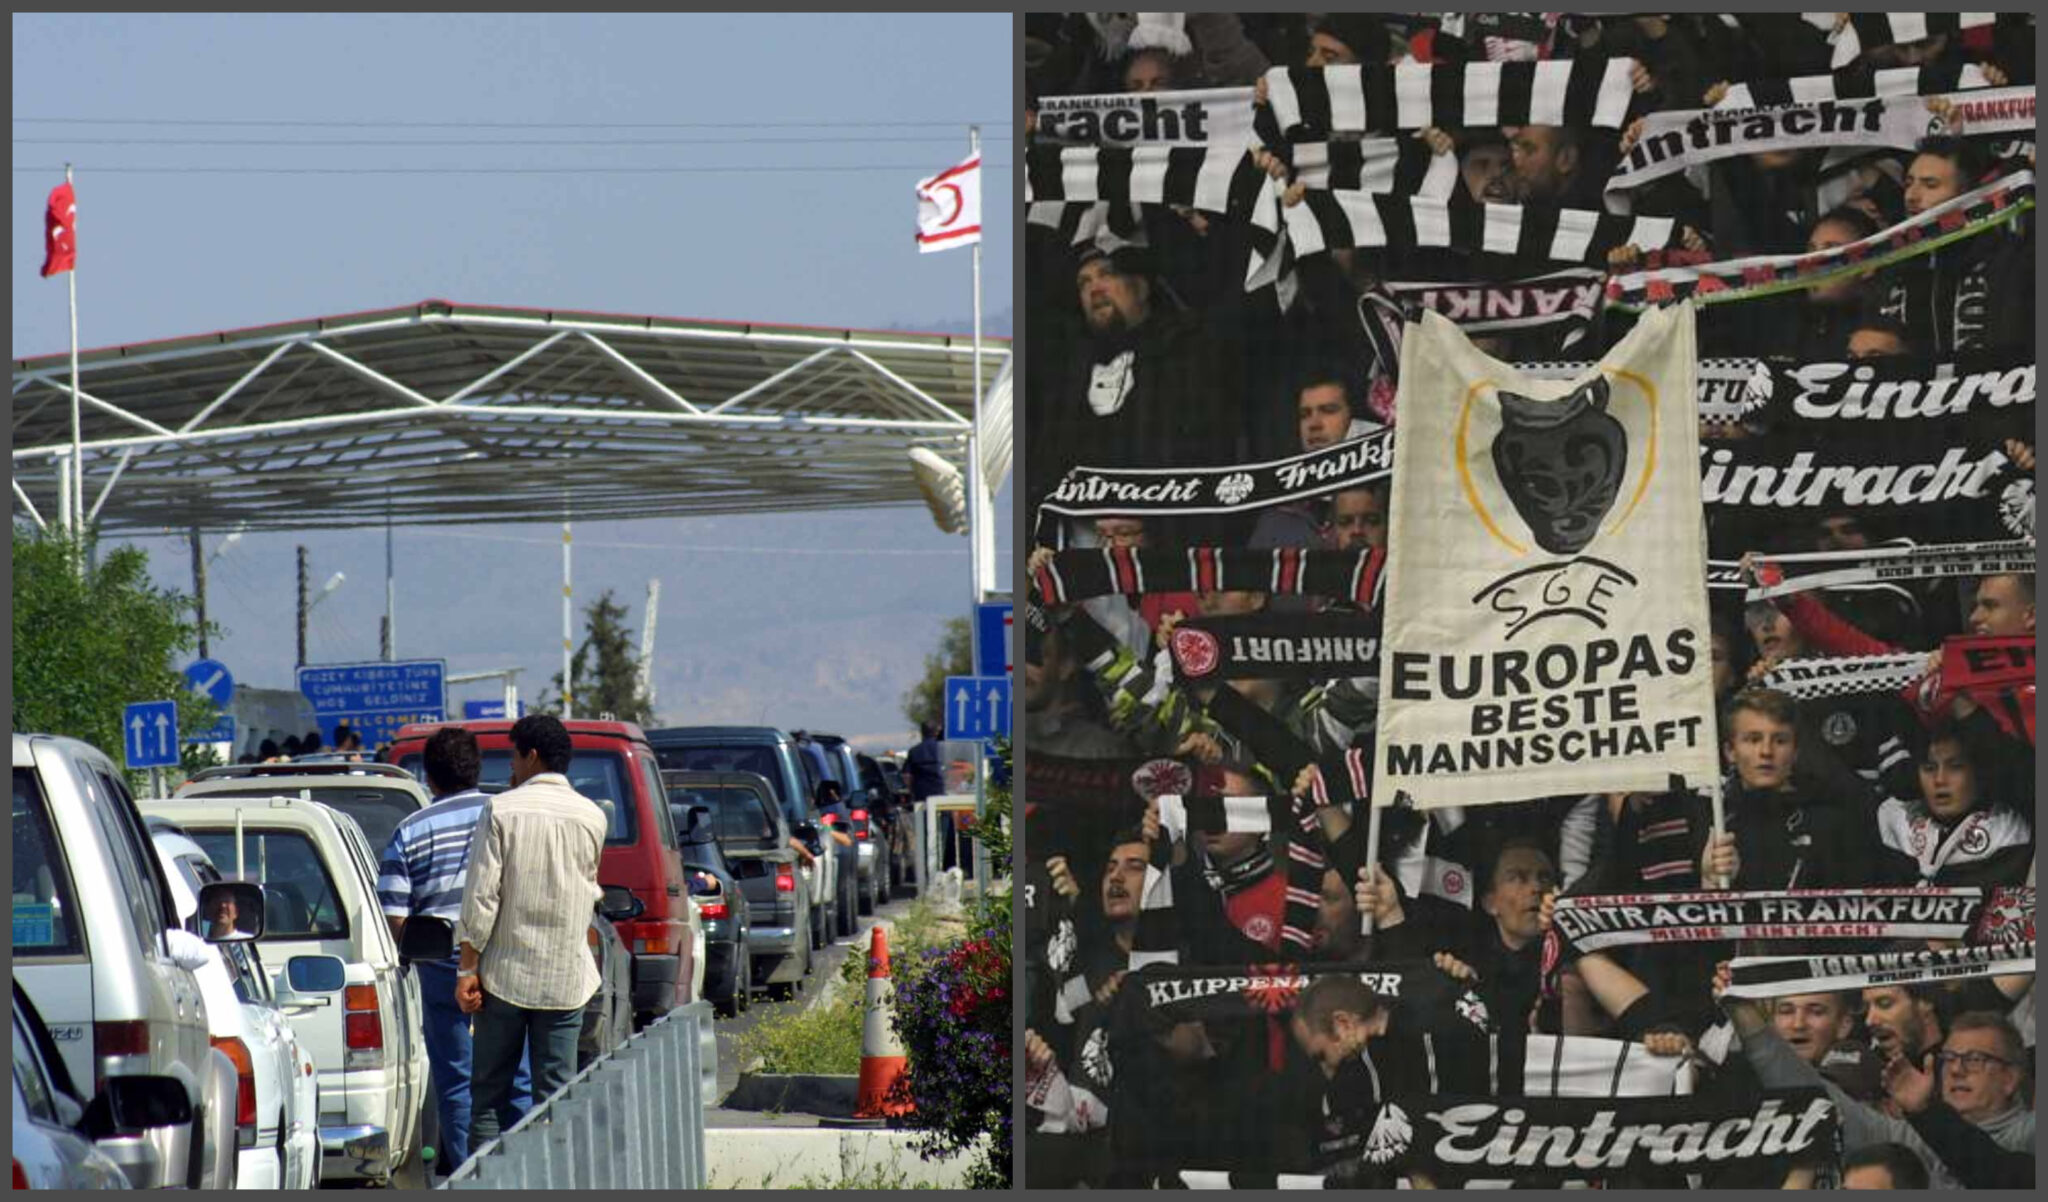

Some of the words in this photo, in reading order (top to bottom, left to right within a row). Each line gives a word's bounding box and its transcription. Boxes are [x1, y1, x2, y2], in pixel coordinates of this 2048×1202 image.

[1491, 569, 1623, 627] SGE
[1392, 628, 1696, 700] EUROPAS
[1471, 684, 1640, 736] BESTE
[1387, 716, 1701, 776] MANNSCHAFT
[1553, 901, 1747, 941] EINTRACHT
[1761, 897, 1982, 924] FRANKFURT
[1425, 1098, 1833, 1170] Eintracht
